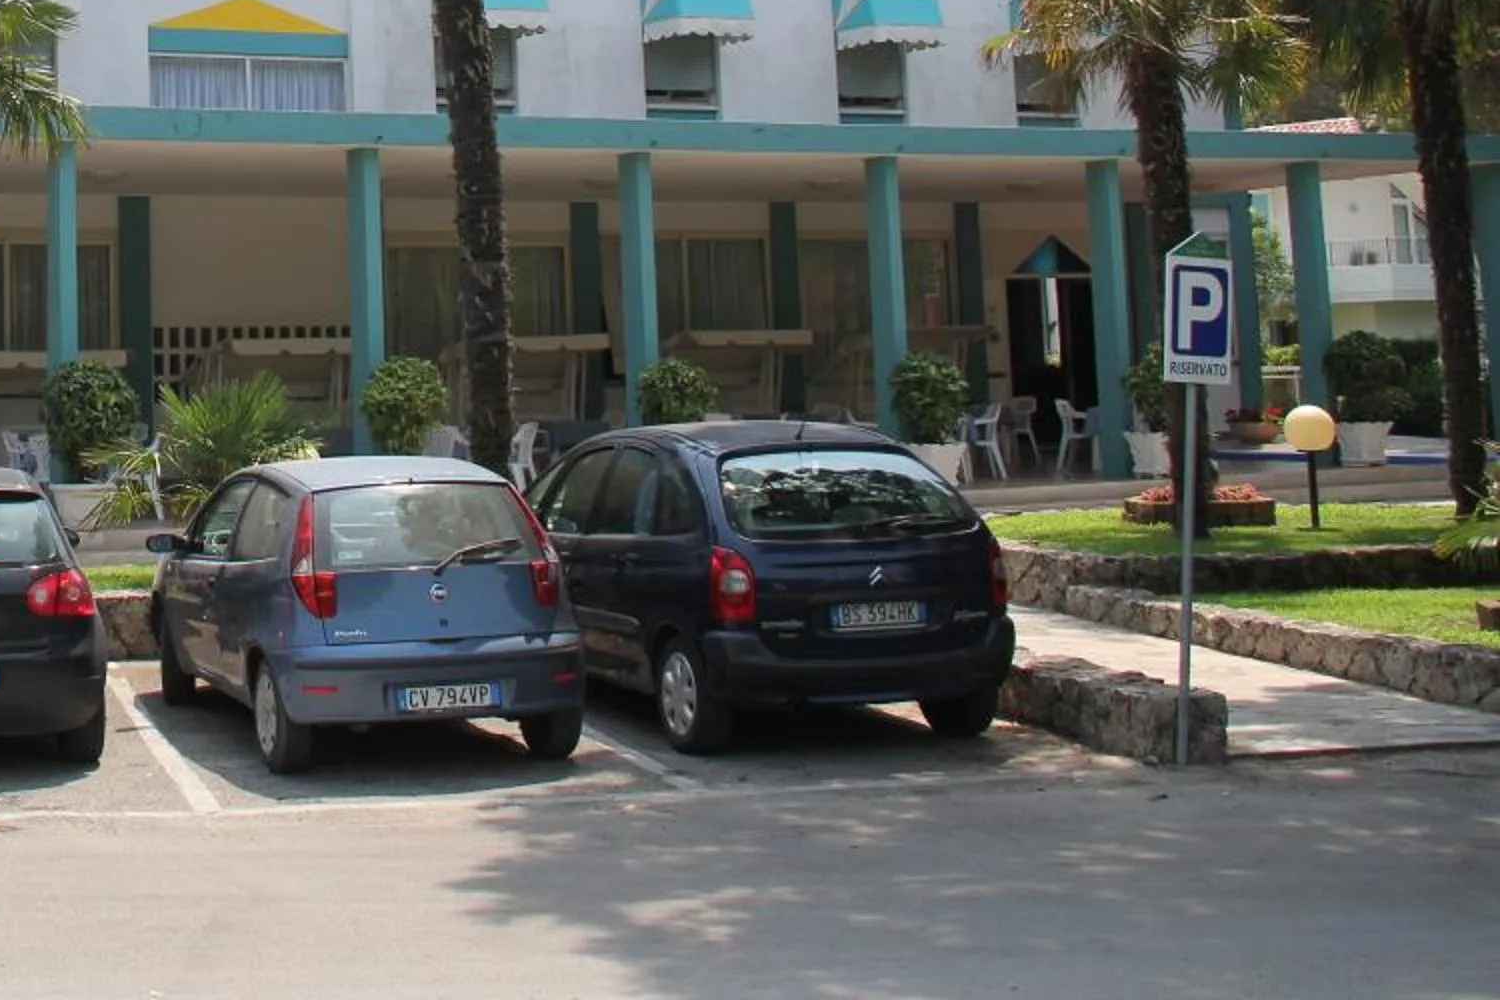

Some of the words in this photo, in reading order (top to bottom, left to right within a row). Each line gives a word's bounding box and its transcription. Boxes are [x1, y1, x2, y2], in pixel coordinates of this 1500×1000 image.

[1177, 270, 1223, 350] P
[1169, 361, 1227, 377] RISERVATO
[408, 688, 429, 707] CV
[435, 685, 489, 706] 794VP
